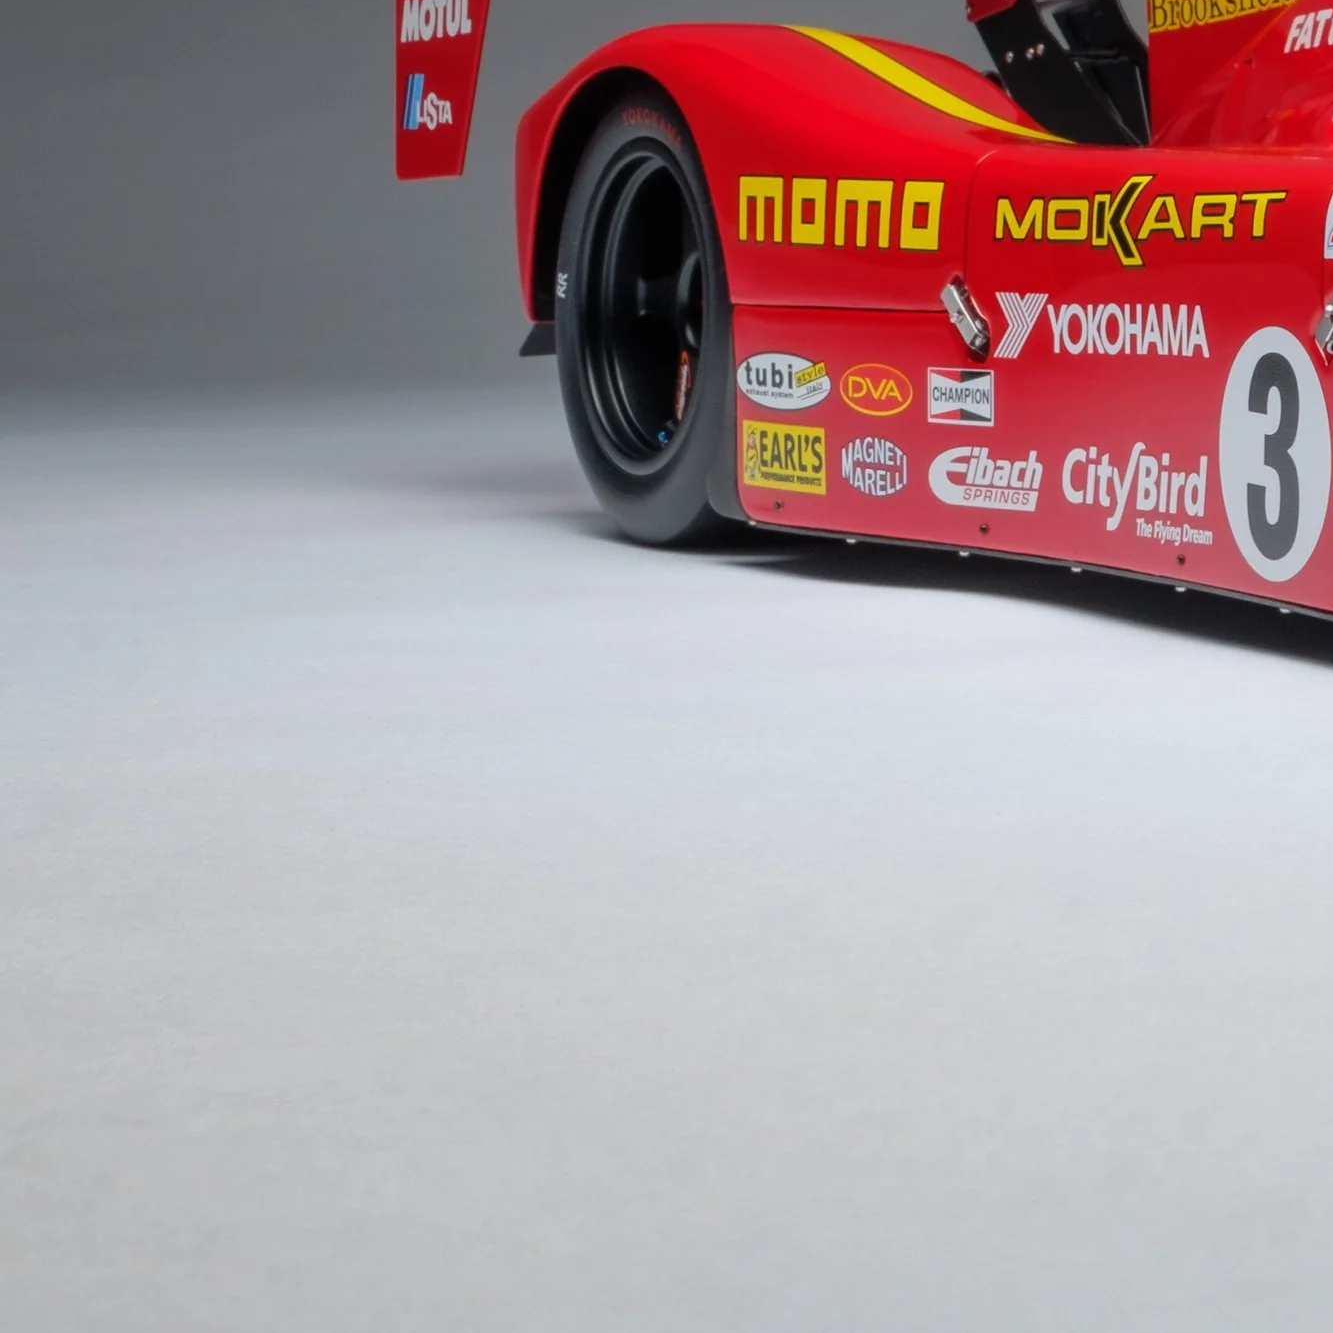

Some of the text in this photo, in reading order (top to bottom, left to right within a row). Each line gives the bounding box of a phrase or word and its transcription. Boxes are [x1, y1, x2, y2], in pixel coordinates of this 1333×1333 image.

[416, 92, 452, 130] LISTA
[994, 174, 1288, 267] MOKART
[1047, 303, 1209, 358] YOKOHAMA
[745, 361, 793, 389] tubi
[848, 376, 903, 403] DVA
[932, 387, 989, 405] CHAMPION
[760, 430, 823, 474] EARL'S
[928, 446, 1043, 495] Eibach
[1247, 352, 1300, 561] 3
[963, 488, 1030, 506] SPRINGS
[1062, 442, 1208, 531] CityBird
[1136, 518, 1213, 546] The Flying Dream
